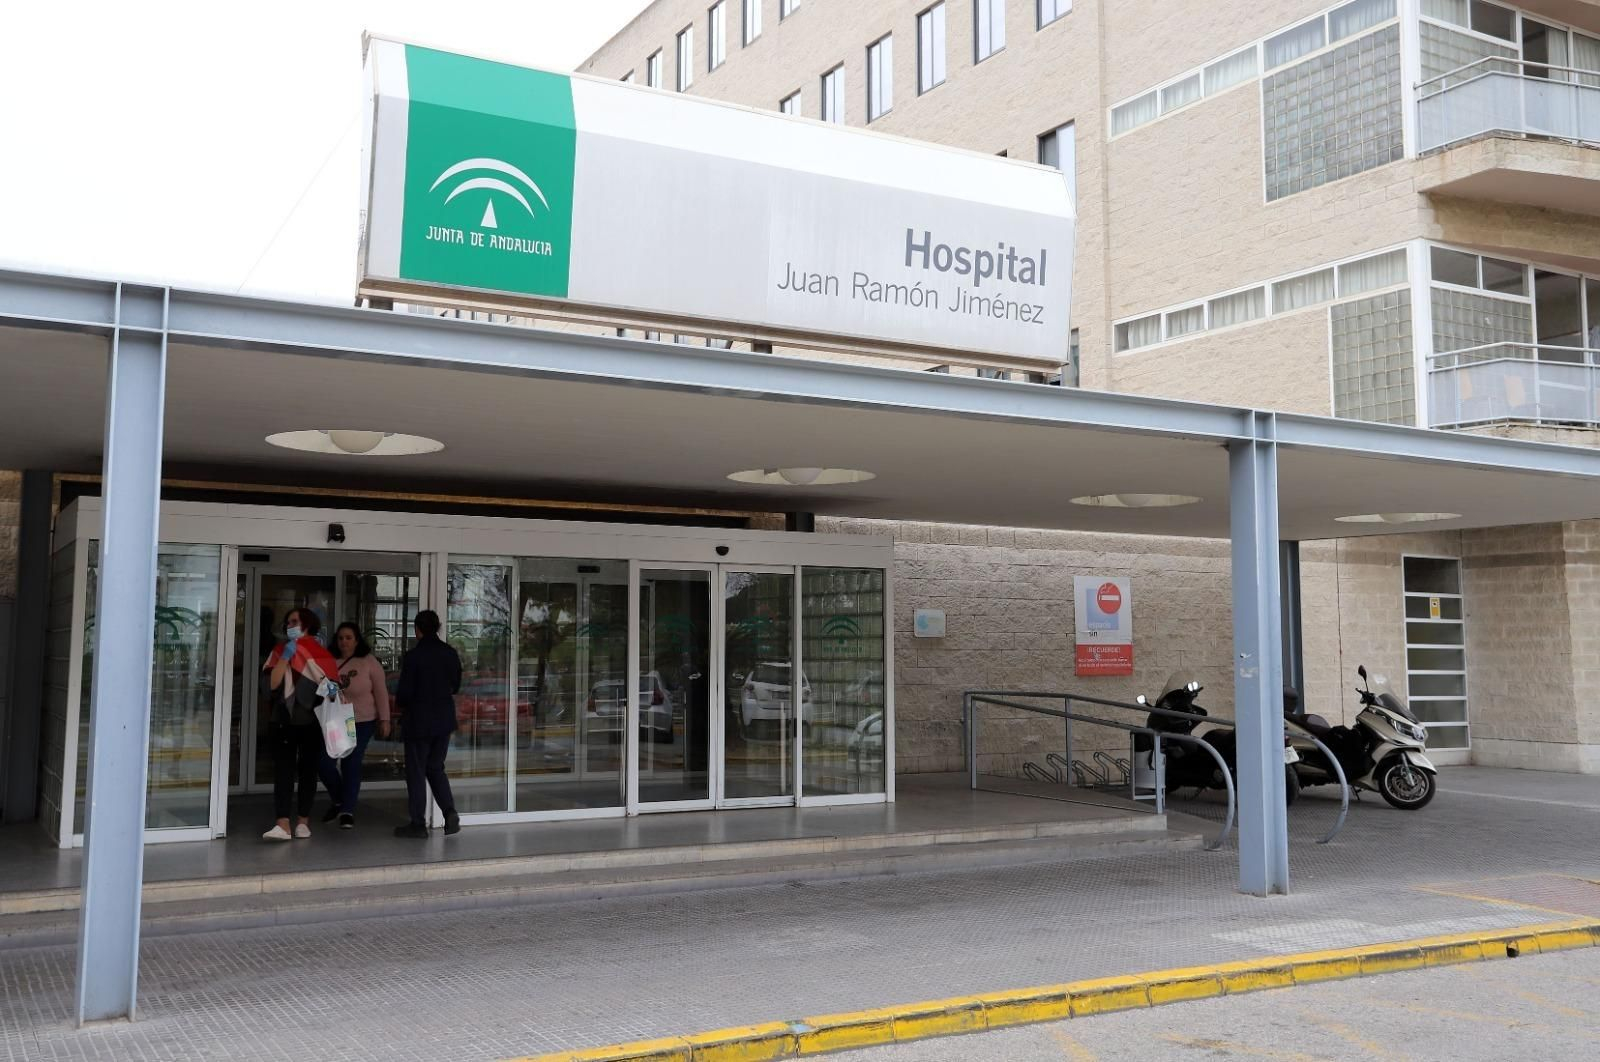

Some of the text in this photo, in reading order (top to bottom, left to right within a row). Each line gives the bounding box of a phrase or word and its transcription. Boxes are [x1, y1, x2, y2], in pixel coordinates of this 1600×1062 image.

[426, 226, 552, 256] JUNTA DE ANDALUCIA
[905, 228, 1047, 287] Hospital
[777, 262, 1044, 325] Juan Ramón Jiménez
